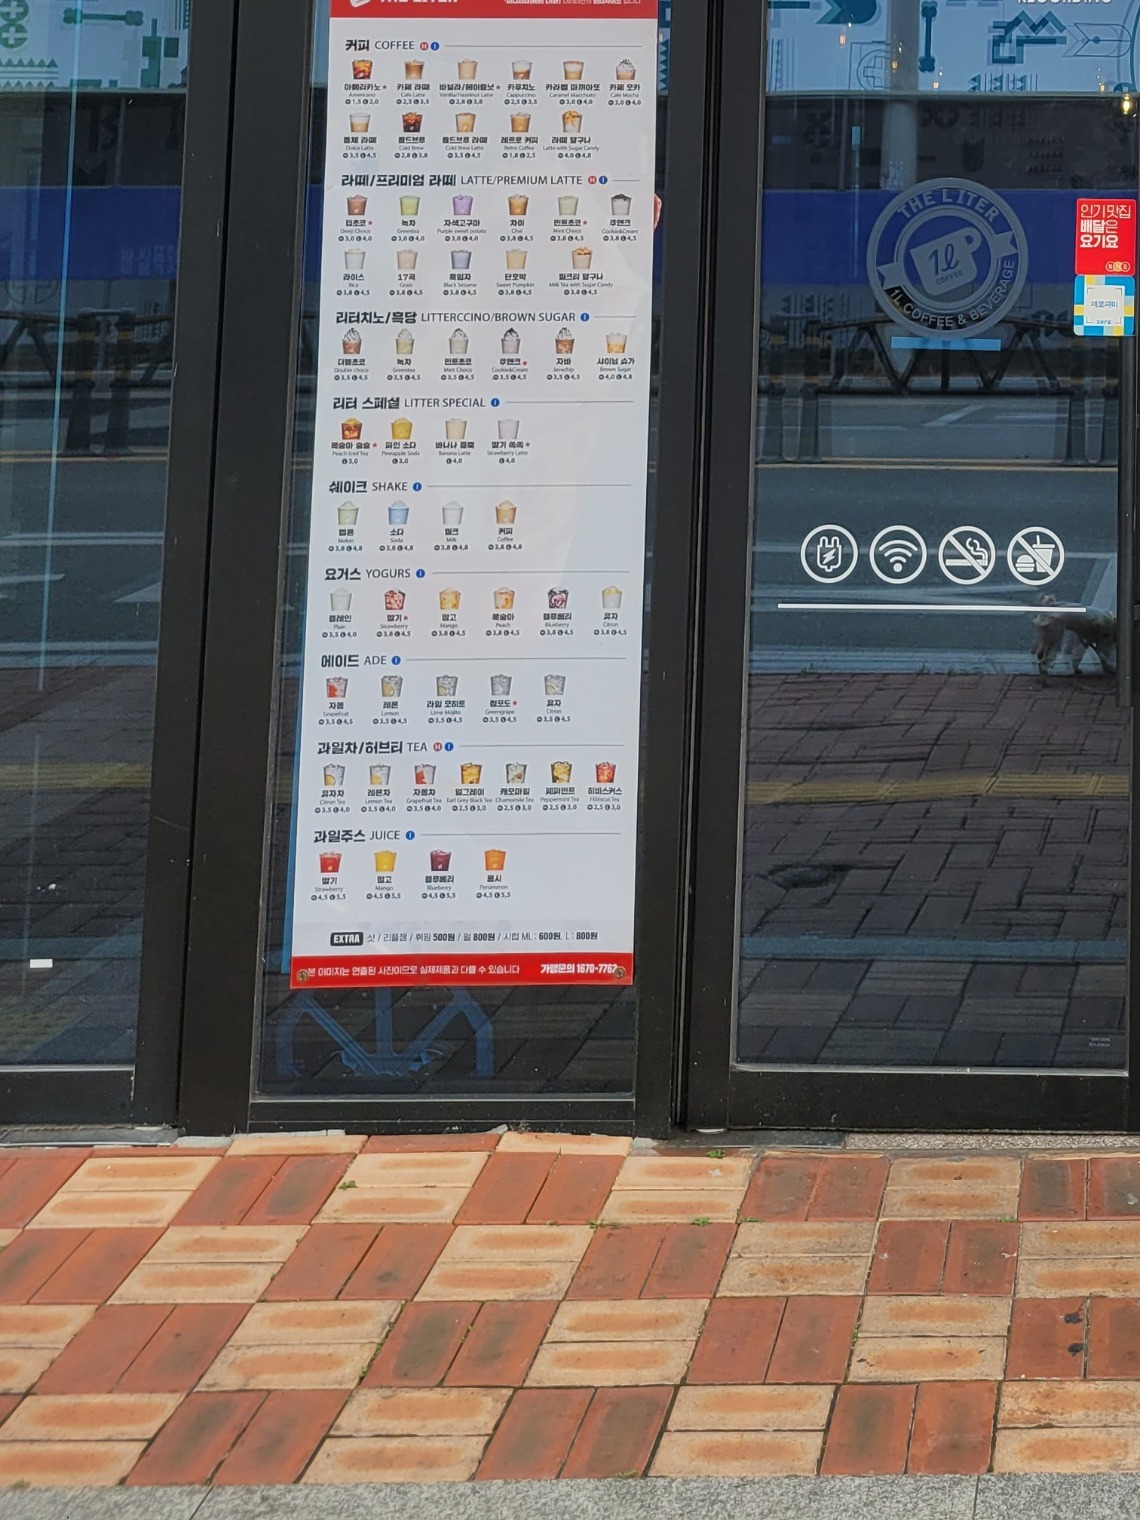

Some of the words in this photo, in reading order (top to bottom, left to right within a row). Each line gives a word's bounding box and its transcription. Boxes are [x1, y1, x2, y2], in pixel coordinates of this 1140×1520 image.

[345, 39, 370, 51] 커피
[374, 41, 415, 50] COFFEE
[341, 175, 425, 186] 라떼/프리미엄
[429, 175, 456, 186] 라떼
[461, 176, 548, 185] LATTE/PREMIUM
[550, 176, 582, 185] LATTE
[898, 193, 936, 220] THE
[943, 189, 1000, 222] LITER
[1080, 220, 1118, 233] 배달은
[1080, 235, 1118, 248] 요기요
[936, 270, 964, 284] COFFEE
[904, 303, 953, 327] COFFEE
[958, 314, 966, 324] &
[971, 260, 1014, 321] BEVERAGE
[336, 312, 417, 324] 리터치노/흑당
[421, 313, 536, 322] LITTERCCINO/BROWN
[538, 313, 576, 322] SUGAR
[333, 397, 357, 409] 리터
[362, 397, 400, 409] 스페셜
[405, 398, 439, 407] LITTER
[443, 398, 486, 407] SPECIAL
[329, 481, 367, 493] 쉐이크
[372, 482, 408, 491] SHAKE
[325, 568, 361, 580] 요거스
[366, 569, 410, 578] YOGURS
[321, 655, 359, 667] 에이드
[364, 656, 387, 665] ADE
[318, 741, 402, 754] 과일차/허브티
[407, 742, 427, 752] TEA
[314, 831, 365, 843] 과일주스
[370, 831, 400, 840] JUICE
[334, 935, 360, 943] EXTRA
[433, 933, 455, 941] 500원
[474, 933, 495, 941] 800원
[576, 932, 597, 940] 800원
[318, 968, 349, 976] 이미지는
